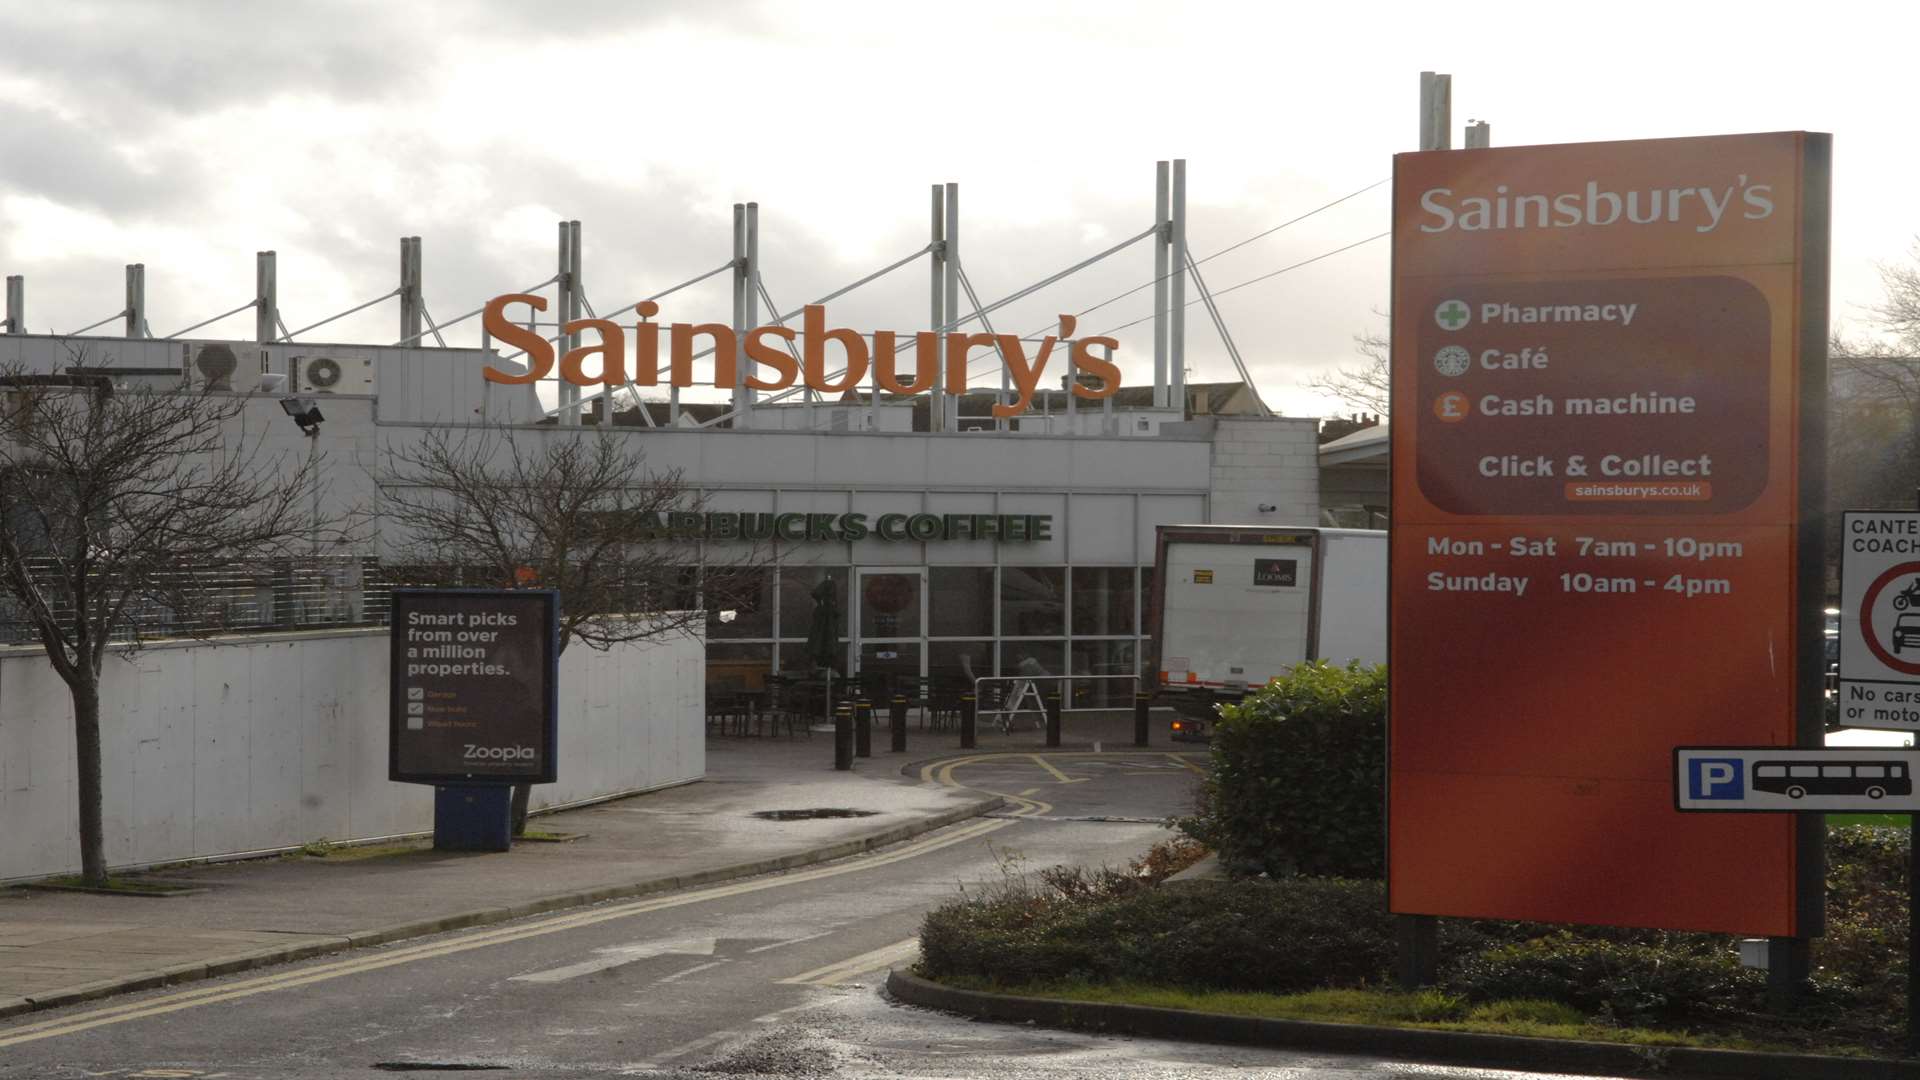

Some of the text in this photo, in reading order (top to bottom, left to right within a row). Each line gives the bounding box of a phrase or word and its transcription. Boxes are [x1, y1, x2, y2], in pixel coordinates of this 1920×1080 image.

[1419, 173, 1774, 233] Sainsbury's
[1481, 301, 1638, 327] Pharmacy
[482, 293, 1122, 418] Sainsbury's
[1480, 346, 1550, 370] Café
[1479, 393, 1554, 417] Cash
[1565, 391, 1697, 415] machine
[1478, 454, 1712, 478] Click & Collect
[1575, 483, 1702, 498] sainsburys.co.uk
[876, 513, 1053, 541] COFFEE
[1427, 537, 1484, 556] Mon
[1509, 536, 1557, 557] Sat
[1576, 537, 1637, 557] 7am
[1664, 537, 1744, 562] 10pm
[1427, 572, 1529, 596] Sunday
[1560, 573, 1637, 594] 10am
[1663, 573, 1732, 598] 4pm
[408, 611, 518, 628] Smart picks
[407, 628, 499, 642] from over
[407, 645, 486, 658] a million
[407, 662, 511, 677] properties.
[1850, 686, 1876, 702] No
[1847, 707, 1920, 722] or moto
[463, 744, 535, 761] Zoopla
[1700, 762, 1735, 796] P
